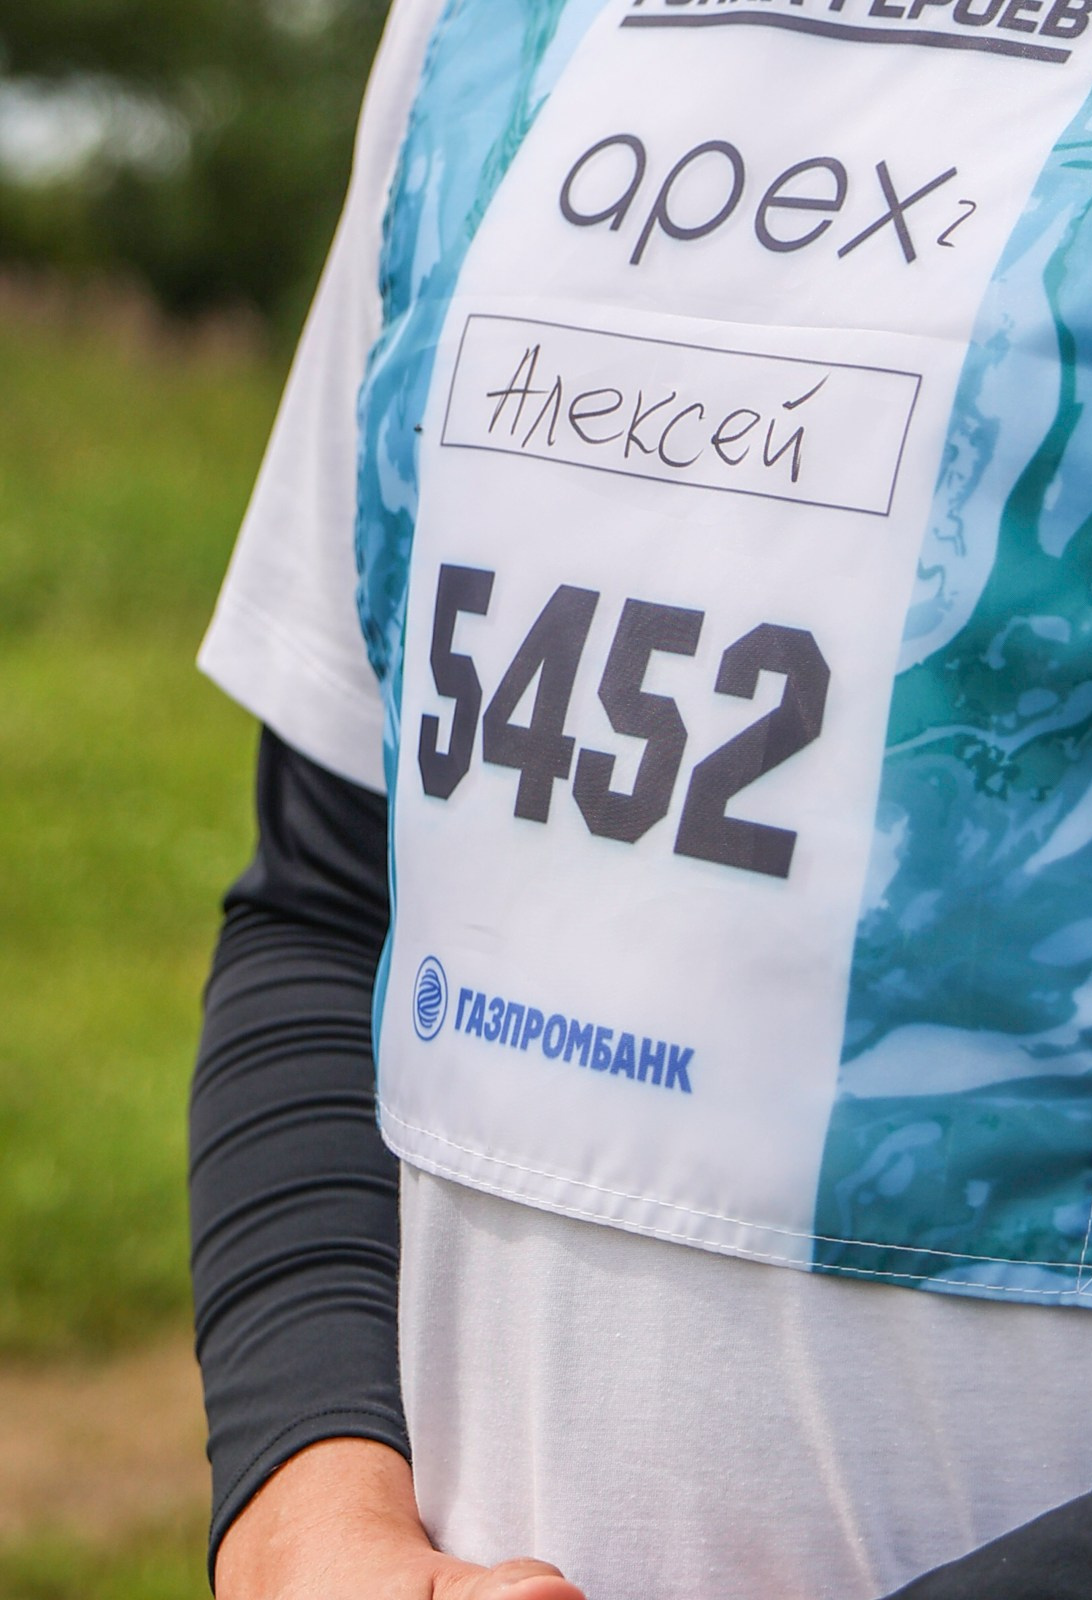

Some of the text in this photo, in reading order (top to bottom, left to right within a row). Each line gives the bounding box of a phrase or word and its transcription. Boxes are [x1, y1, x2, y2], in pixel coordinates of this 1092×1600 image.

[487, 343, 830, 483] Алексей
[418, 563, 831, 879] 5452
[454, 986, 695, 1094] ГАЗПРОМБАНК
